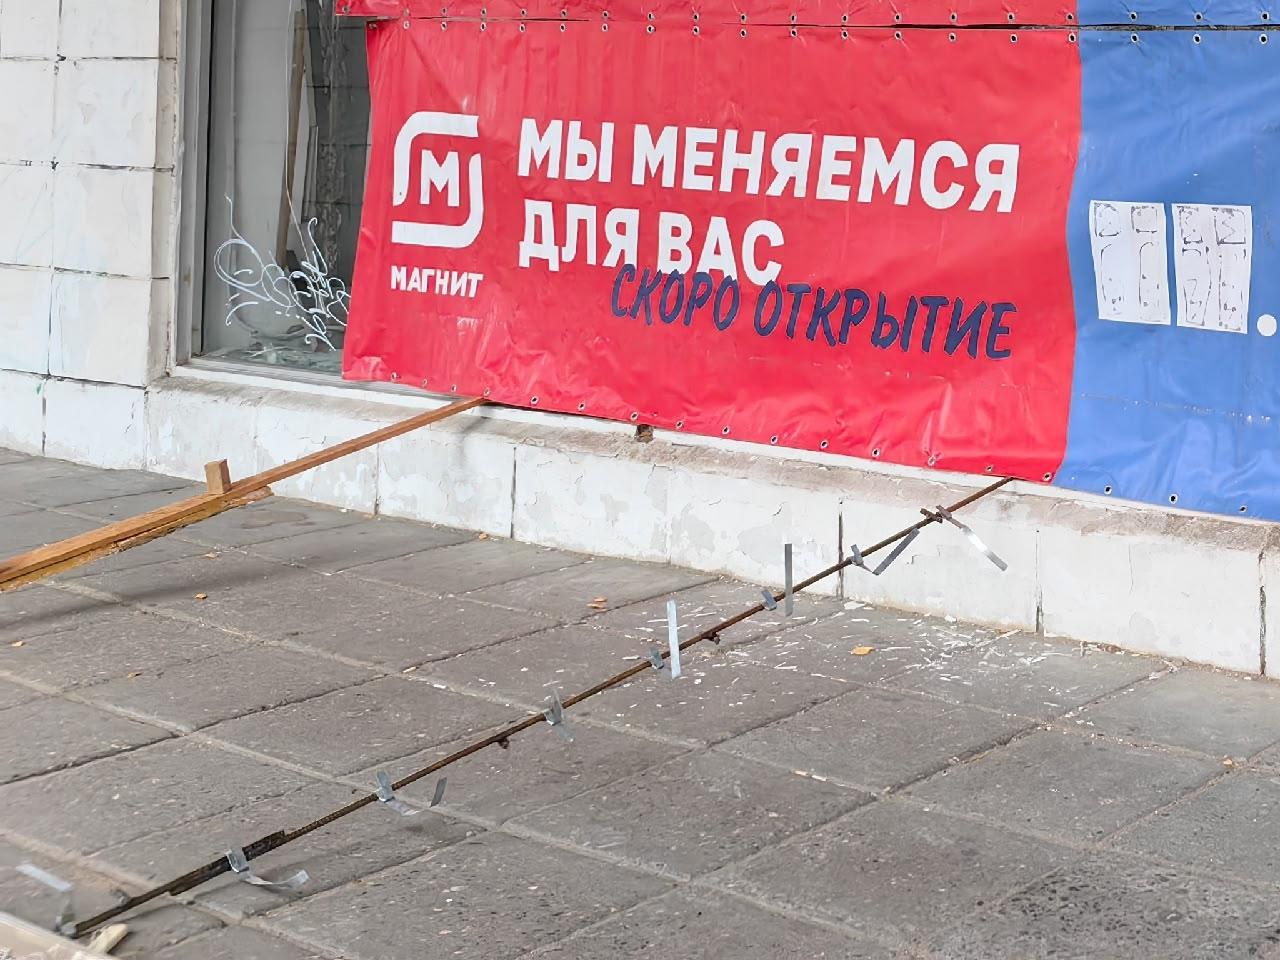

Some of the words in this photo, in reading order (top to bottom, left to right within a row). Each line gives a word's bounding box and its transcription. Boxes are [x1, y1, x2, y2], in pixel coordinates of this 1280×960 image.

[517, 117, 615, 183] МЫ
[631, 123, 1020, 213] МЕНЯЕМСЯ
[390, 265, 484, 298] МАГНИТ
[518, 198, 640, 272] ДЛЯ
[656, 211, 785, 287] ВАС
[611, 263, 740, 331] СКОРО
[753, 279, 1017, 359] ОТКРЫТИЕ
